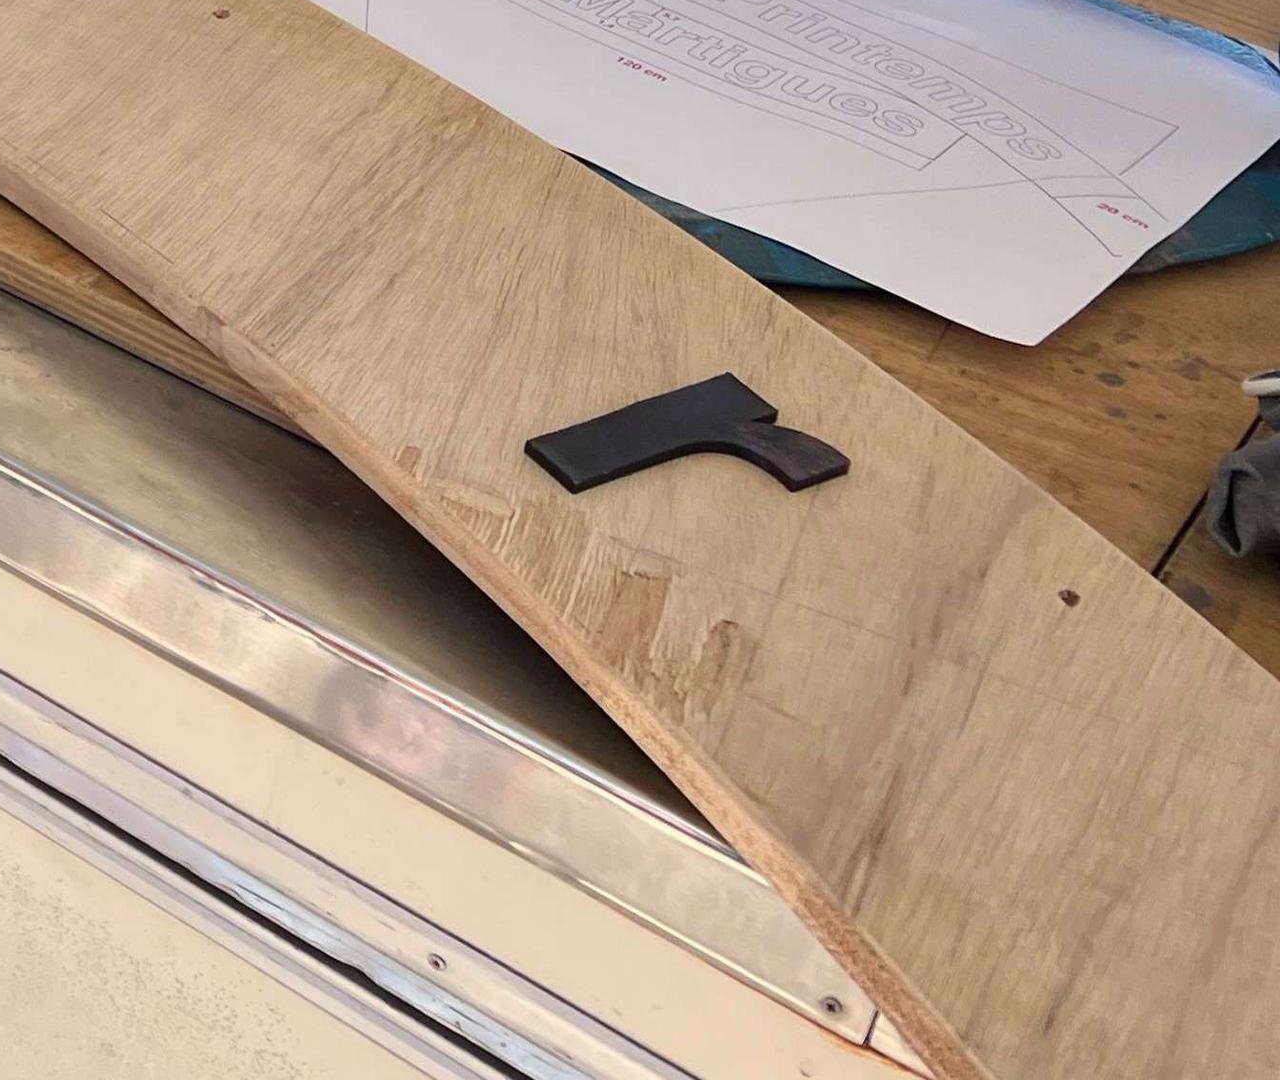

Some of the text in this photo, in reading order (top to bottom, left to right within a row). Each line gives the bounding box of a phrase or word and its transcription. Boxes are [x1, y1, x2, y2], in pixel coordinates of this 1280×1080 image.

[617, 56, 667, 82] 120 cm
[1096, 202, 1149, 229] 20 cm
[524, 371, 851, 494] r
